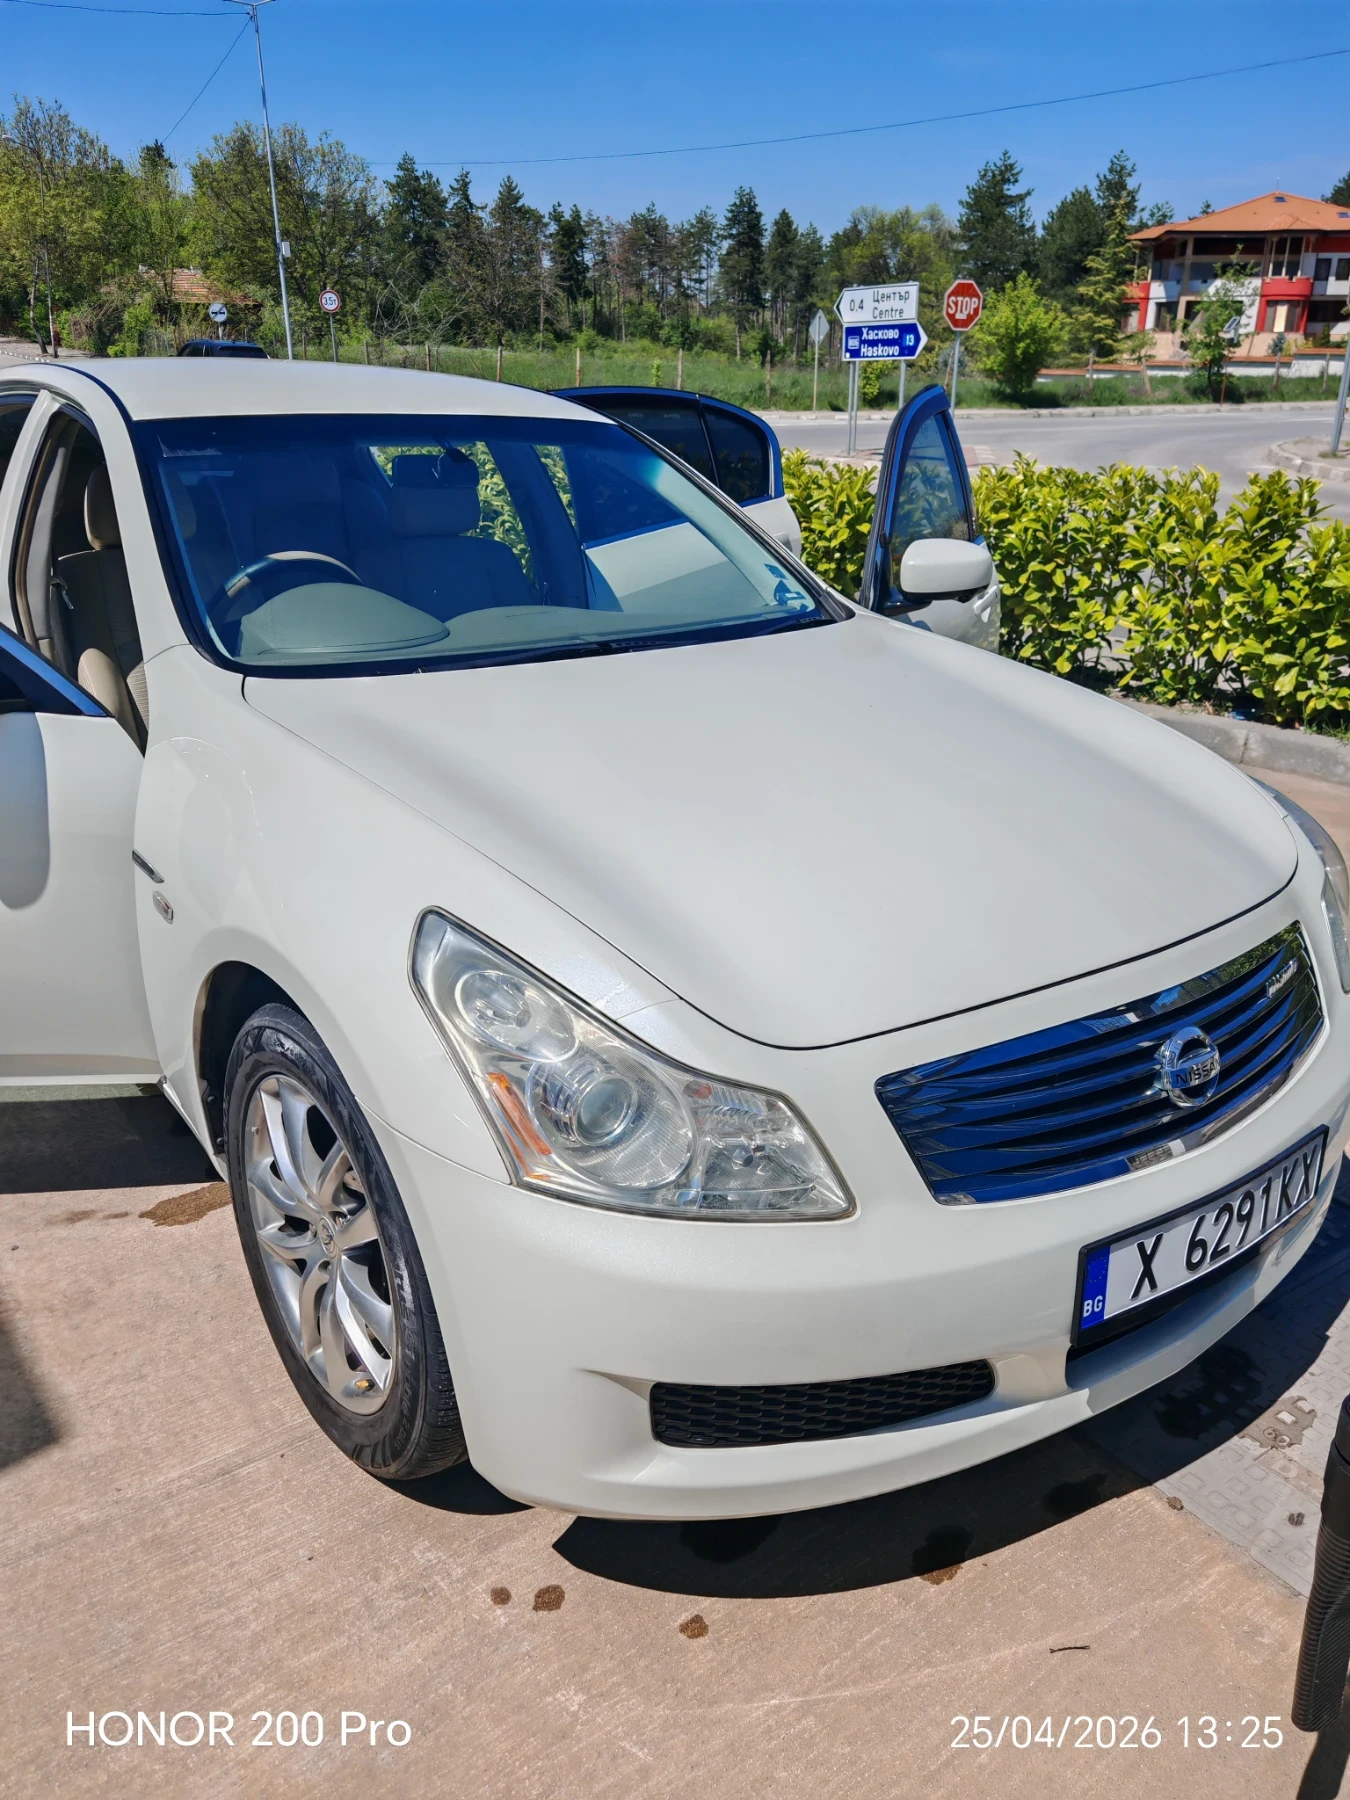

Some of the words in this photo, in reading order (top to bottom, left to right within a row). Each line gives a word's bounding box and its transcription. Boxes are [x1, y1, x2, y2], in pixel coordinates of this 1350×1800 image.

[872, 290, 910, 304] Център
[948, 296, 979, 315] STOP
[872, 307, 904, 319] Centre
[861, 327, 900, 340] Хасково
[905, 334, 915, 346] 13
[860, 343, 900, 357] Haskovo
[1082, 1295, 1104, 1318] BG
